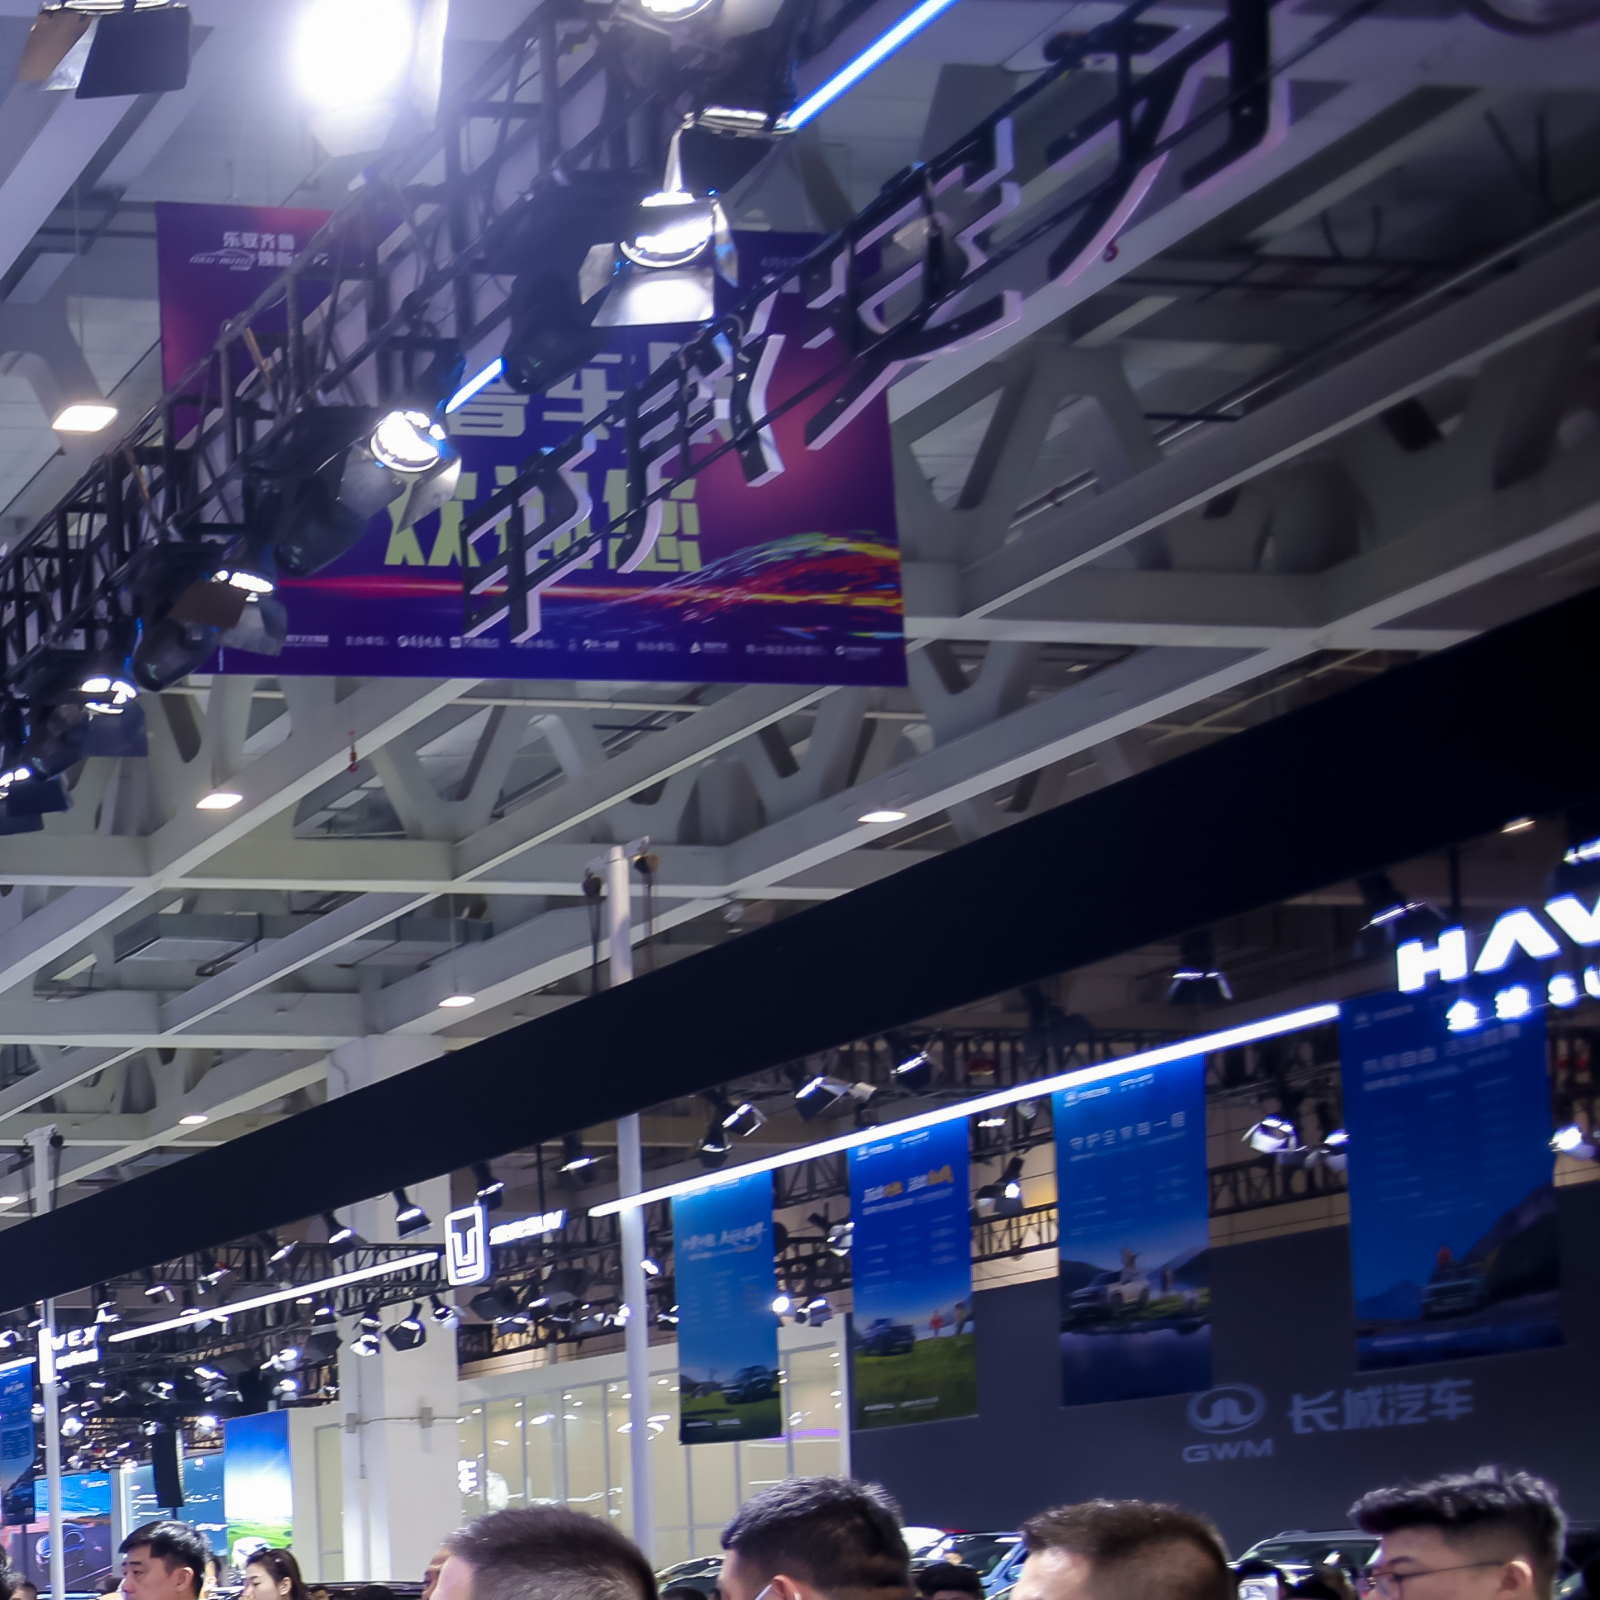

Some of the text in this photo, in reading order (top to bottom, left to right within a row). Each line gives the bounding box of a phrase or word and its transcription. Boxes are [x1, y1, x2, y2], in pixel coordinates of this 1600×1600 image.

[1288, 1379, 1473, 1435] 长城汽车
[1182, 1438, 1274, 1464] GWM
